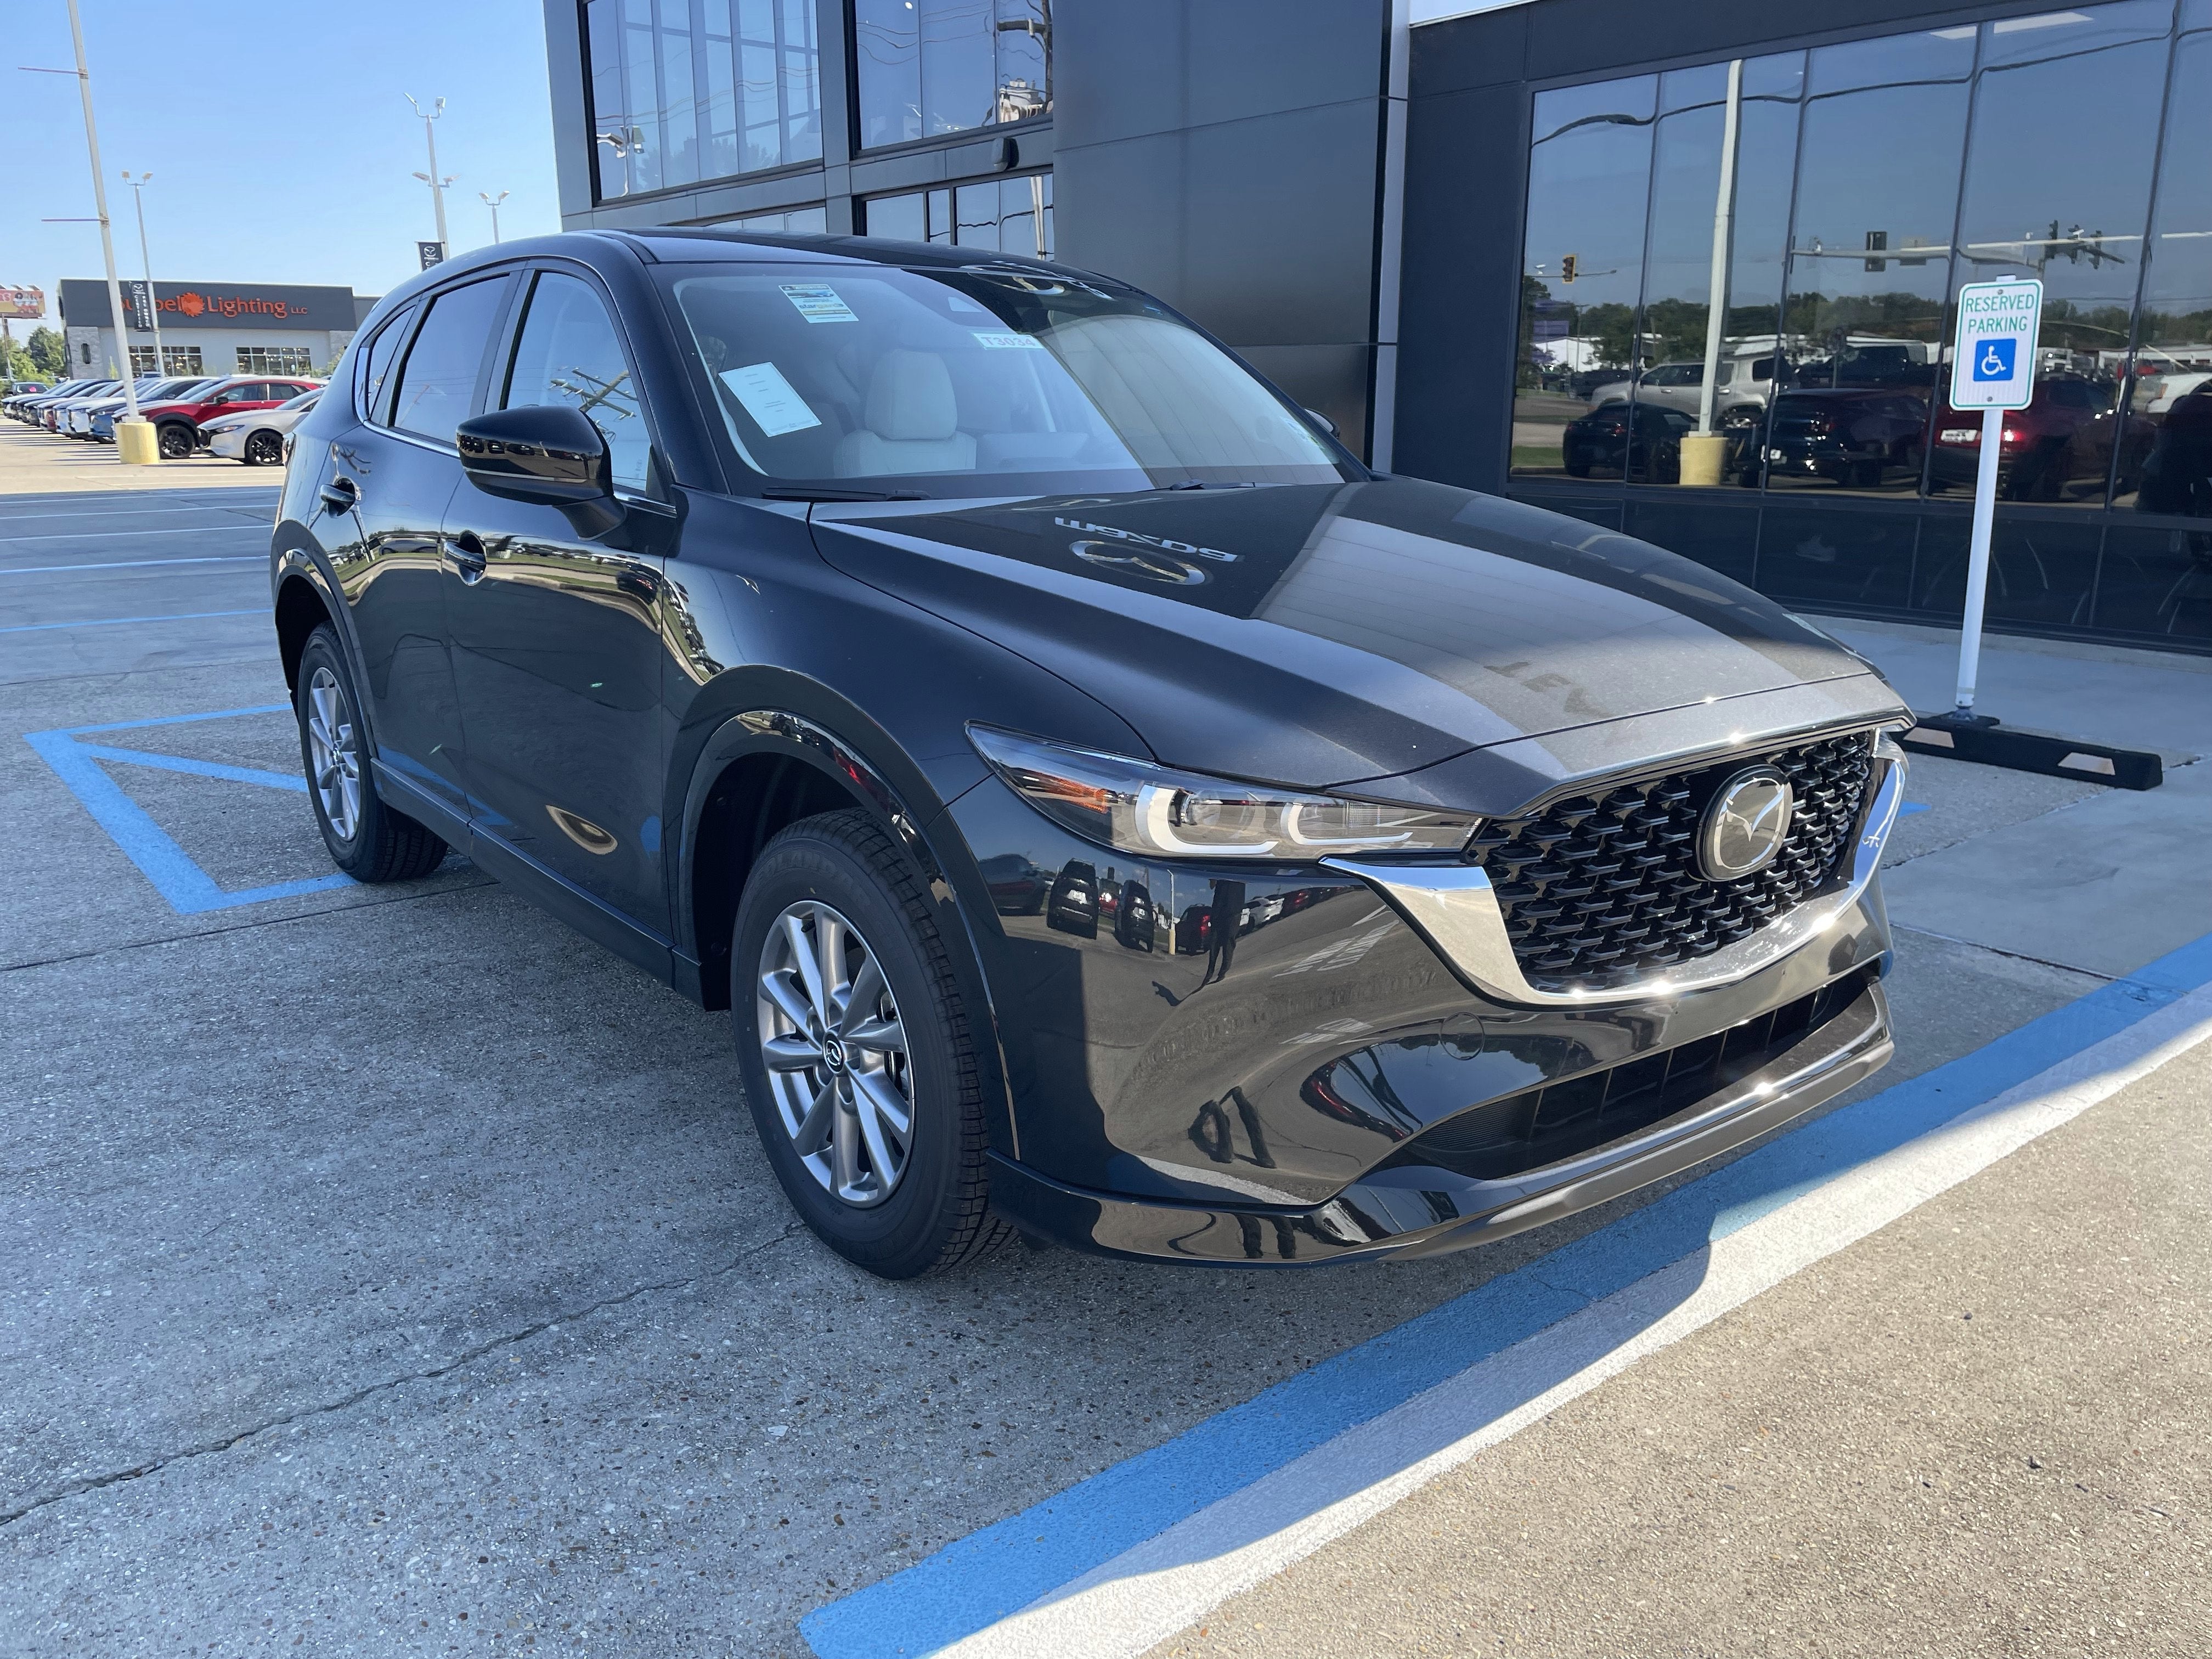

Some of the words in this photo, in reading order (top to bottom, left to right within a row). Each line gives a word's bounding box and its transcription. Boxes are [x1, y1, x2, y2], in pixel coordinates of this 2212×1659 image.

[206, 296, 287, 319] Lighting
[1966, 294, 2034, 312] RESERVED
[1968, 315, 2027, 334] PARKING
[980, 337, 1036, 346] T3034
